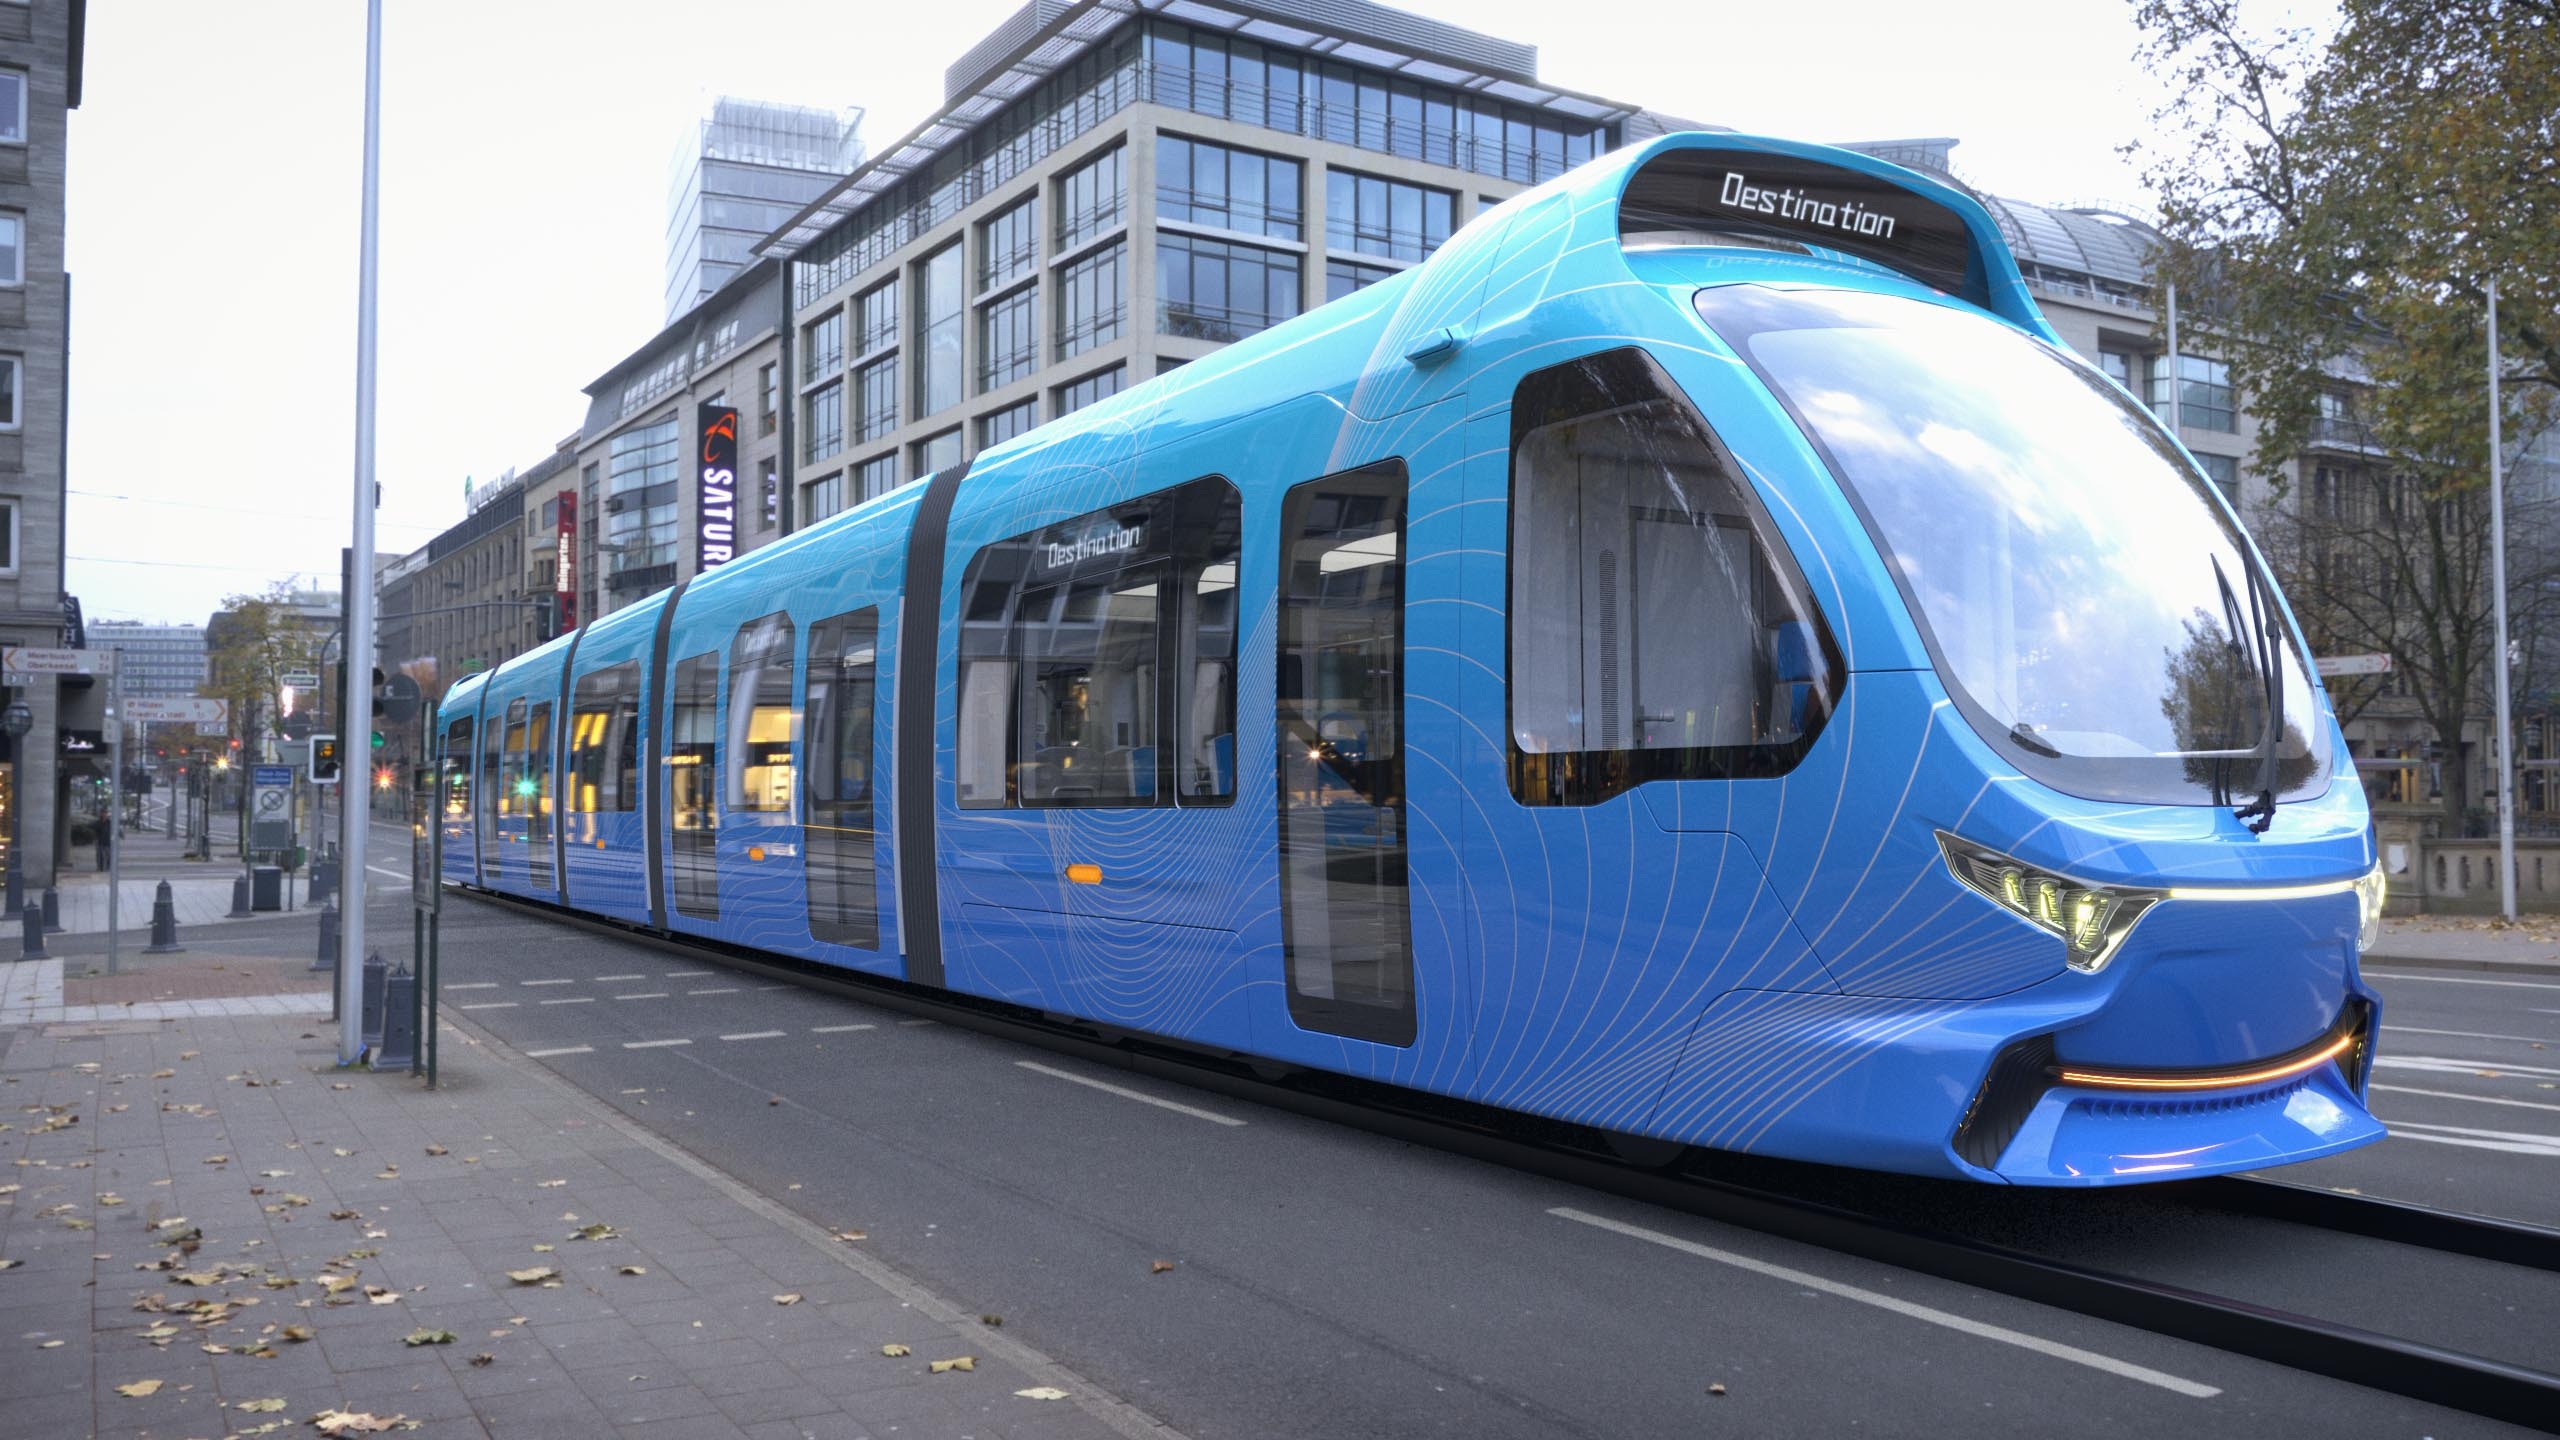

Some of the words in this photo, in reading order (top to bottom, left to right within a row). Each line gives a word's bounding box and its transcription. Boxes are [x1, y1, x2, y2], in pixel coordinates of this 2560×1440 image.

[1720, 172, 1895, 239] Destination
[703, 467, 734, 573] SATUR
[1047, 525, 1140, 569] Destination
[64, 599, 77, 650] SCH
